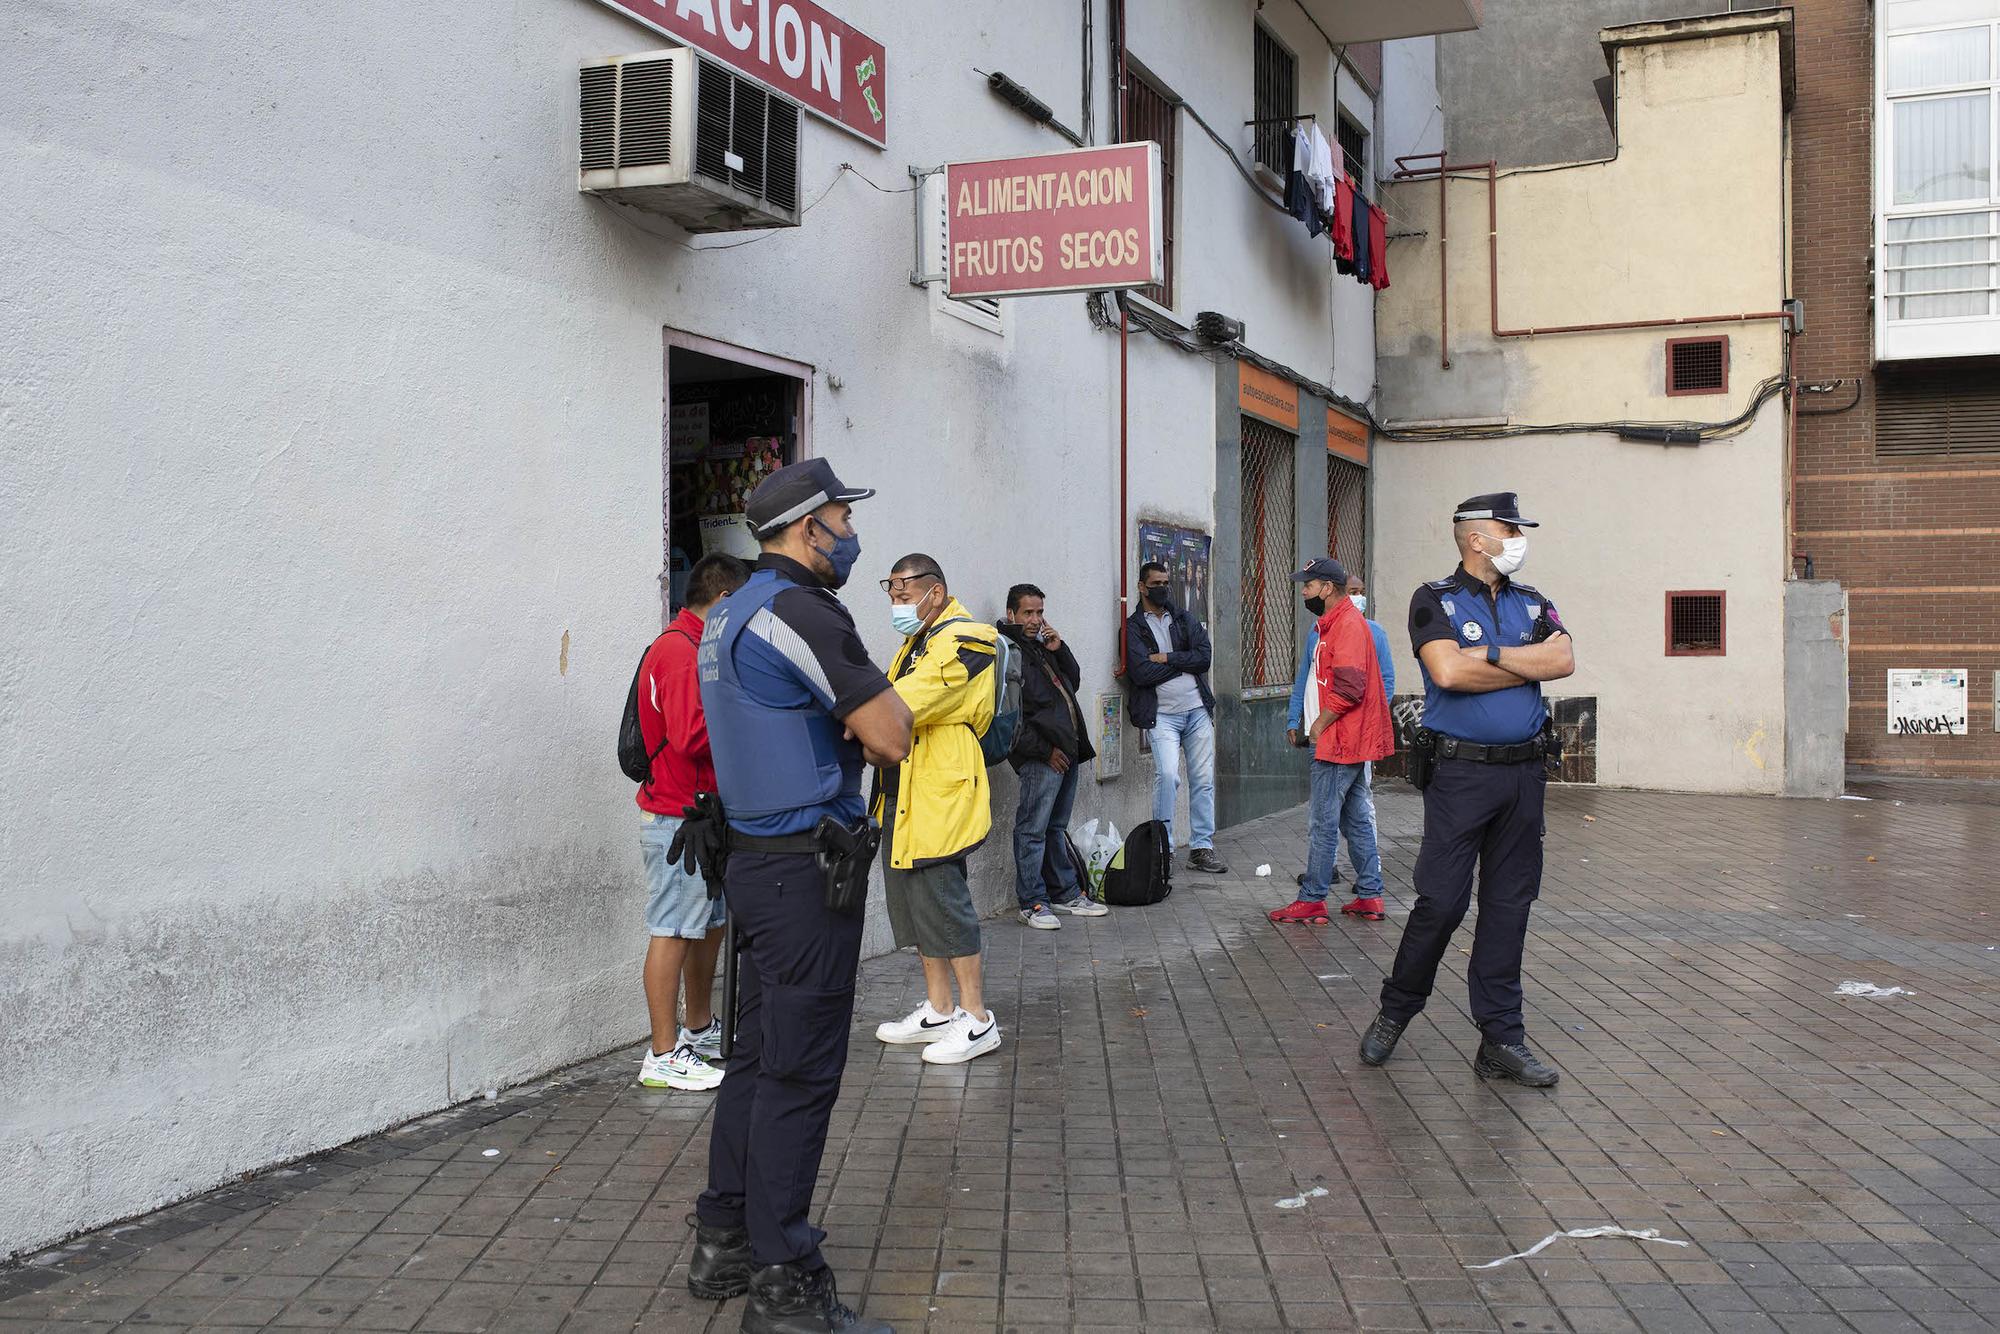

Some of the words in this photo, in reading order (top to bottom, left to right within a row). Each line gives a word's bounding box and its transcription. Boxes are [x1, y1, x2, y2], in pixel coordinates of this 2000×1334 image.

[956, 165, 1133, 217] ALIMENTACION
[954, 235, 1044, 278] FRUTOS
[1059, 227, 1140, 271] SECOS
[699, 515, 738, 528] Trident
